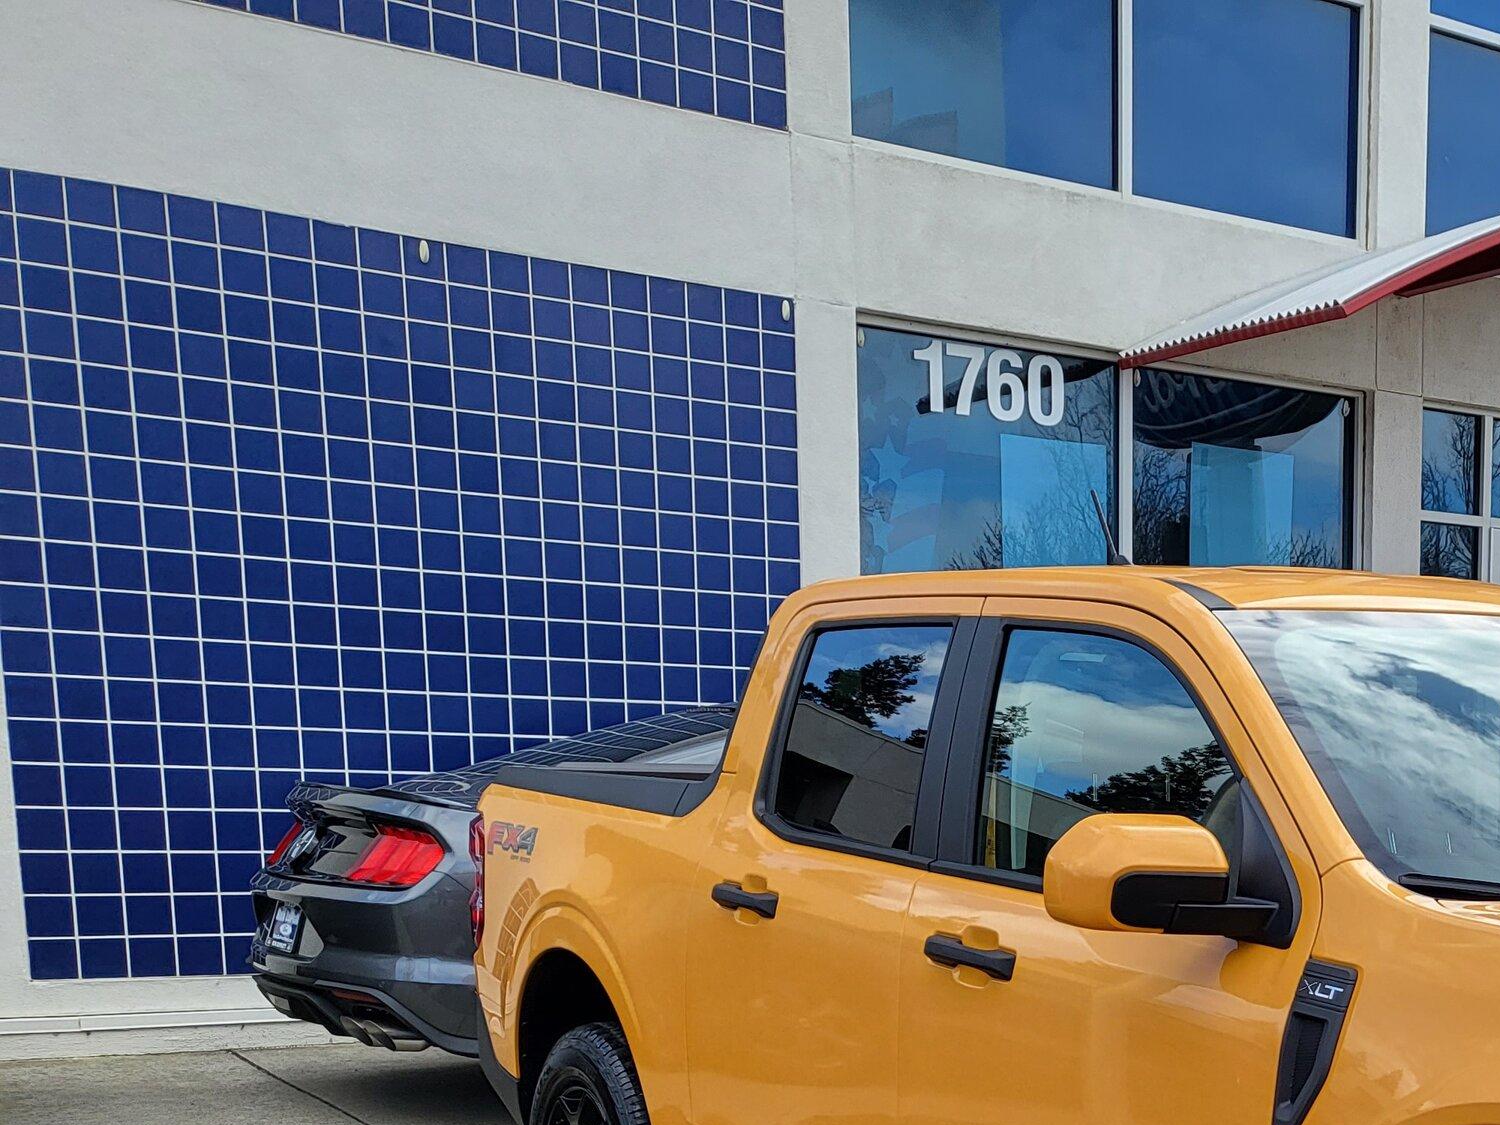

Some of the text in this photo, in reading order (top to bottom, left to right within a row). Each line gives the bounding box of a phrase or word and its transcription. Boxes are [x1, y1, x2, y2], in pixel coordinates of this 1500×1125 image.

[913, 340, 1065, 426] 1760
[487, 820, 539, 855] FX4
[1299, 979, 1344, 1000] XLT
